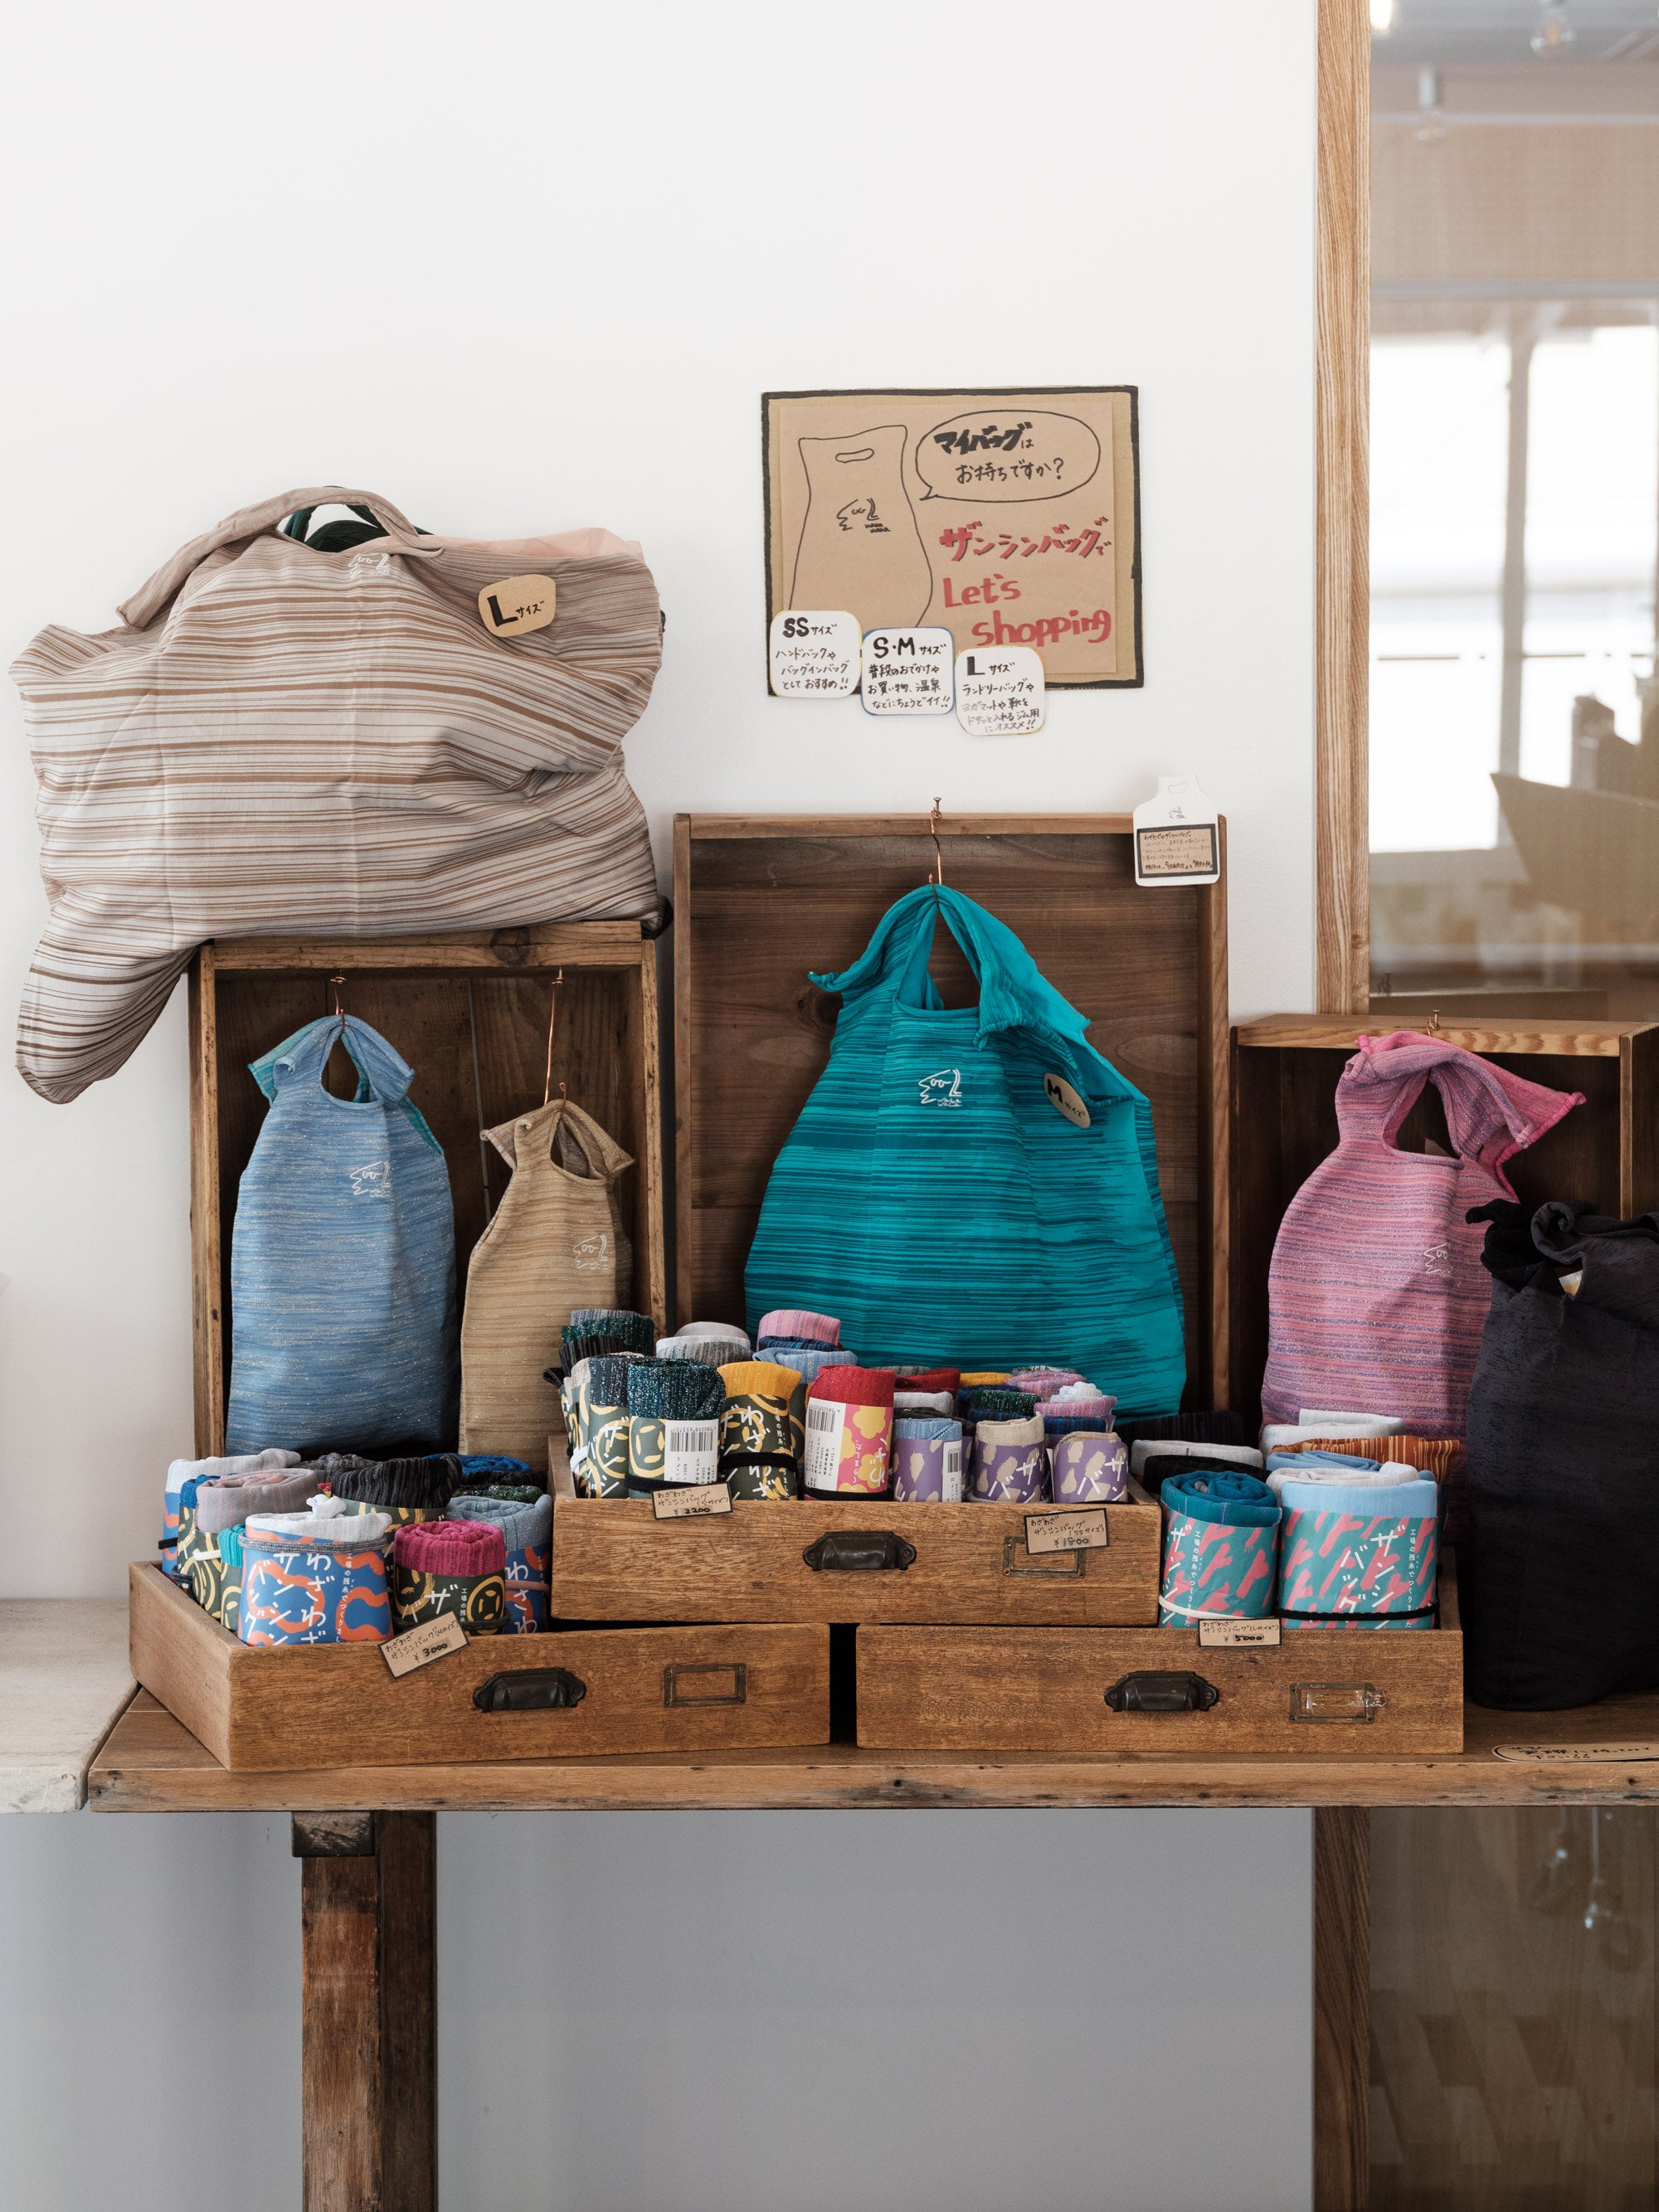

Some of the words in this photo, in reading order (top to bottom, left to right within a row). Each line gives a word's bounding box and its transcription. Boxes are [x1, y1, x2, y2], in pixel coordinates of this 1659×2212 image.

[934, 421, 1034, 455] マイバッグは
[942, 573, 1022, 608] Let's
[971, 610, 1112, 647] shopping
